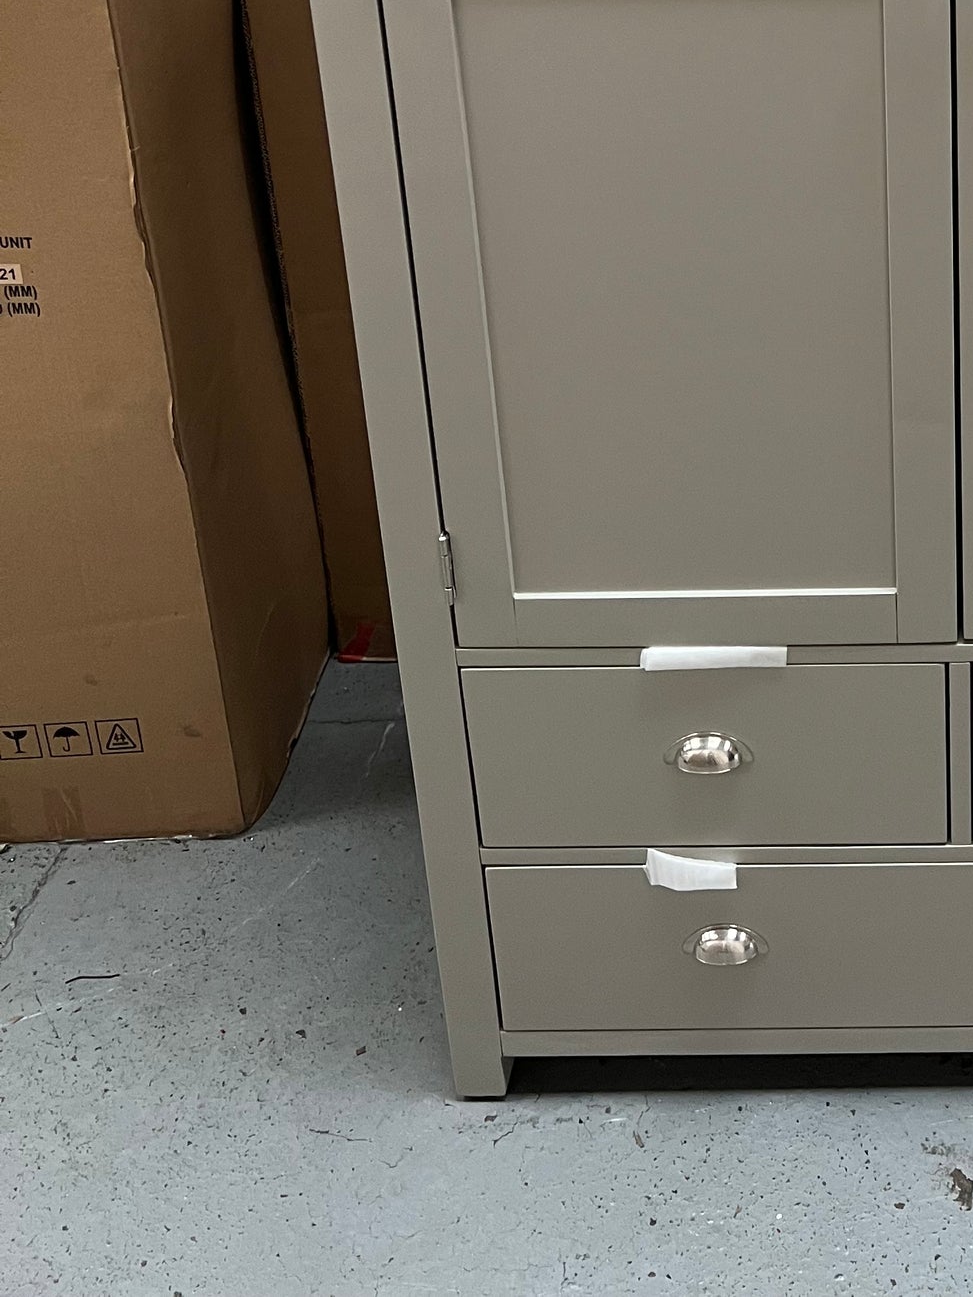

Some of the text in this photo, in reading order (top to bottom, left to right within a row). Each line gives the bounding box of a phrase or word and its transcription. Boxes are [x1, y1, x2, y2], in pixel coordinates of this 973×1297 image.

[0, 236, 33, 249] UNIT
[4, 285, 38, 301] (MM)
[7, 302, 41, 318] (MM)
